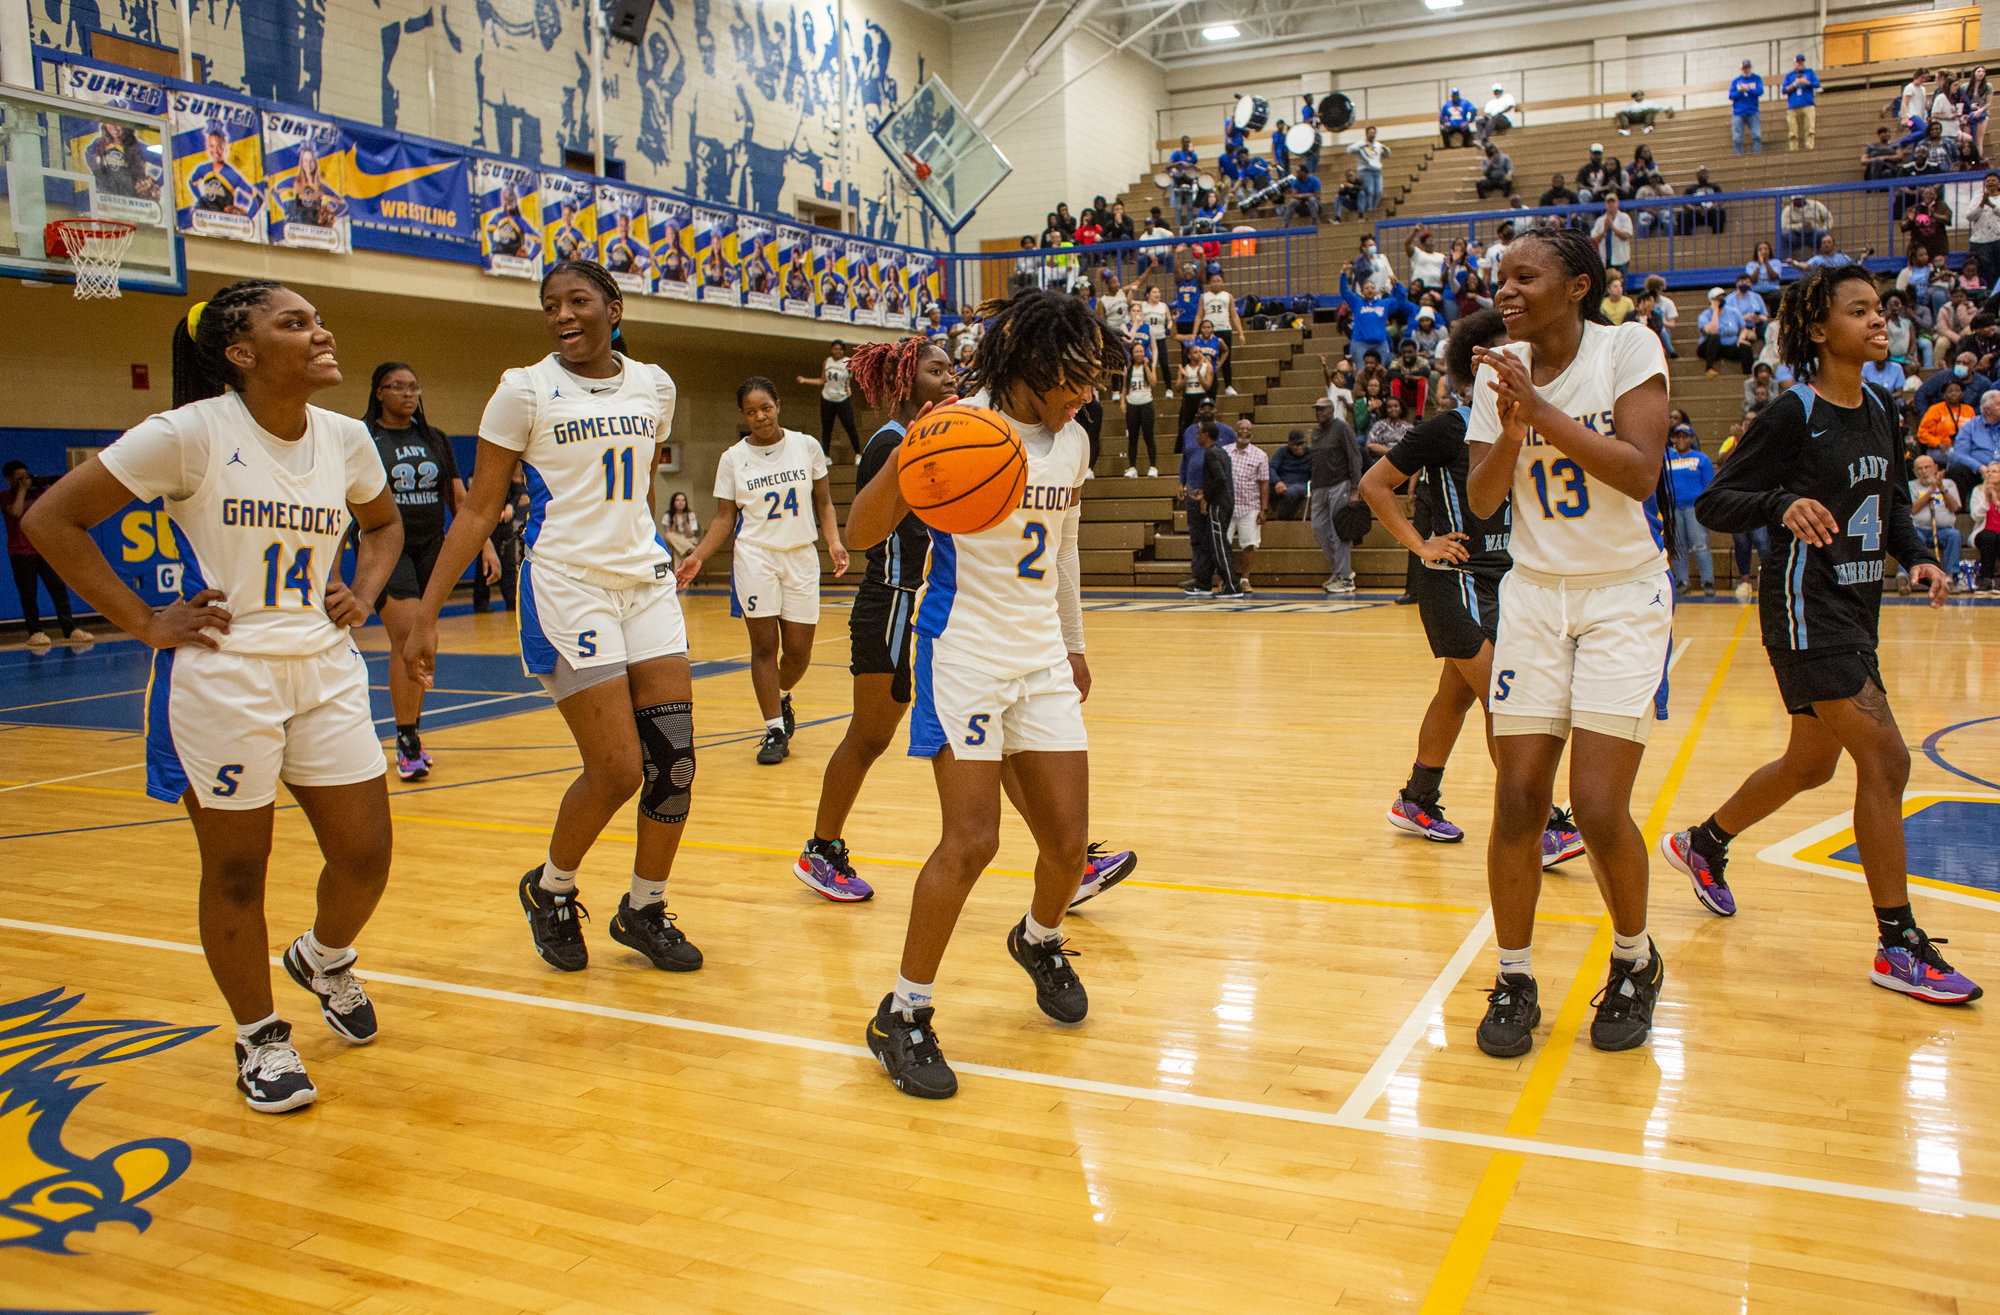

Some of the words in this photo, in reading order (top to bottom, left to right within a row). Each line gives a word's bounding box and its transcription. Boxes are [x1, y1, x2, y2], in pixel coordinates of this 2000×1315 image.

[69, 69, 162, 107] SUMTER
[173, 94, 256, 128] SUMTER
[267, 114, 340, 145] SUMTER
[380, 199, 457, 228] WRESTLING
[553, 415, 656, 446] GAMECOCKS
[907, 420, 952, 447] EVO
[395, 445, 428, 461] LADY
[391, 461, 439, 493] 32
[601, 446, 636, 502] 11
[746, 469, 807, 492] GAMECOCKS
[1848, 455, 1889, 489] LADY
[764, 487, 800, 520] 24
[1016, 485, 1072, 512] ECOCK
[1527, 457, 1591, 521] 13
[222, 497, 342, 536] GAMECOCKS
[1847, 494, 1882, 552] 4
[1016, 519, 1049, 582] 2
[263, 540, 315, 608] 14
[747, 595, 759, 612] S
[577, 629, 599, 658] S
[1493, 669, 1516, 701] S
[964, 713, 992, 747] S
[211, 763, 245, 797] S
